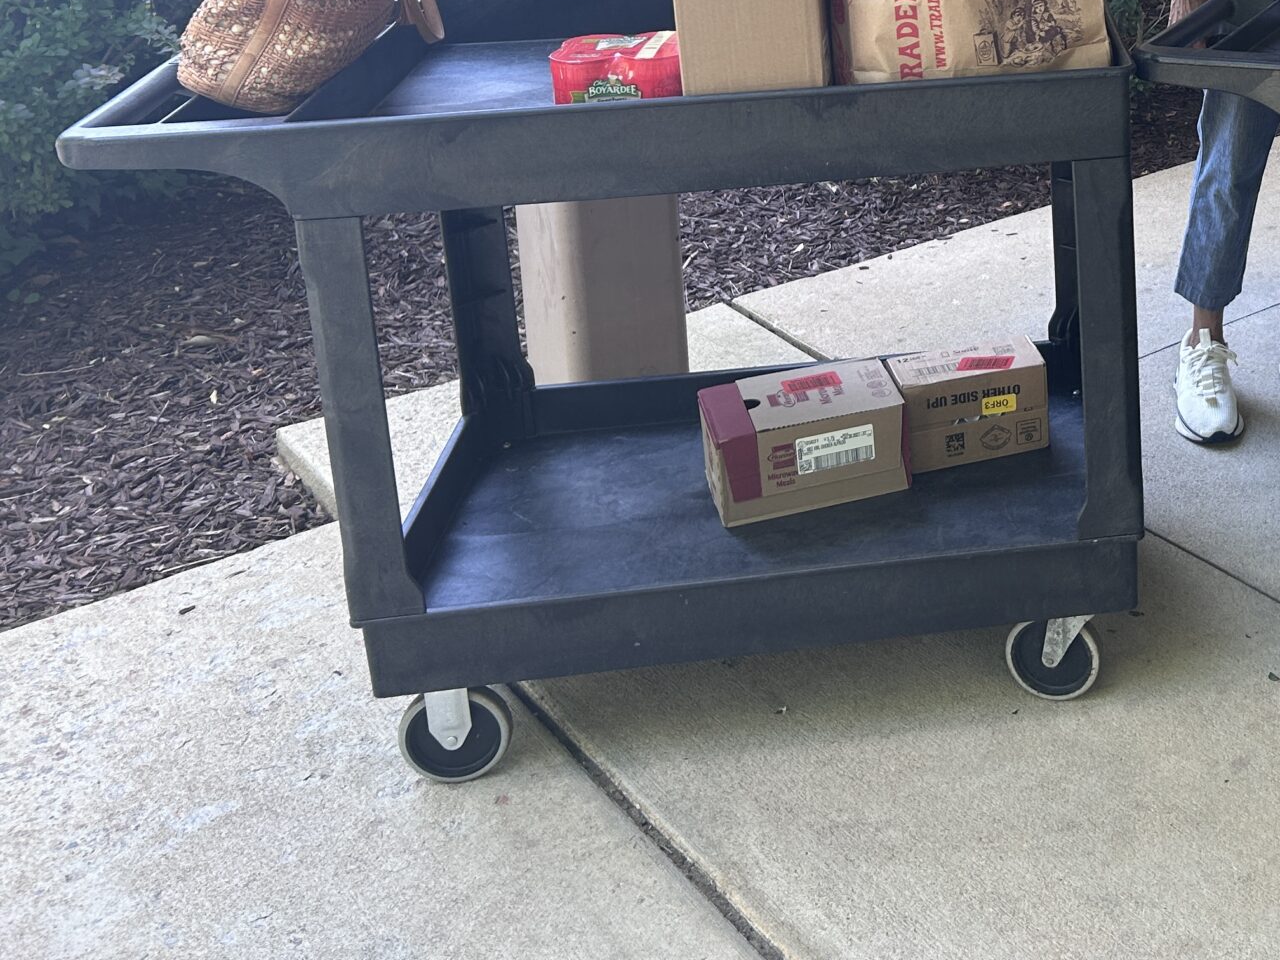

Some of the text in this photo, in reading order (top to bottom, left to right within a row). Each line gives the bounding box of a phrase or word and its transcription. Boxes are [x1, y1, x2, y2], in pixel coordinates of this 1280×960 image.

[588, 84, 638, 97] BOYARDEE
[926, 397, 948, 410] UP!
[951, 394, 979, 406] SIDE
[984, 398, 1009, 410] ORF3
